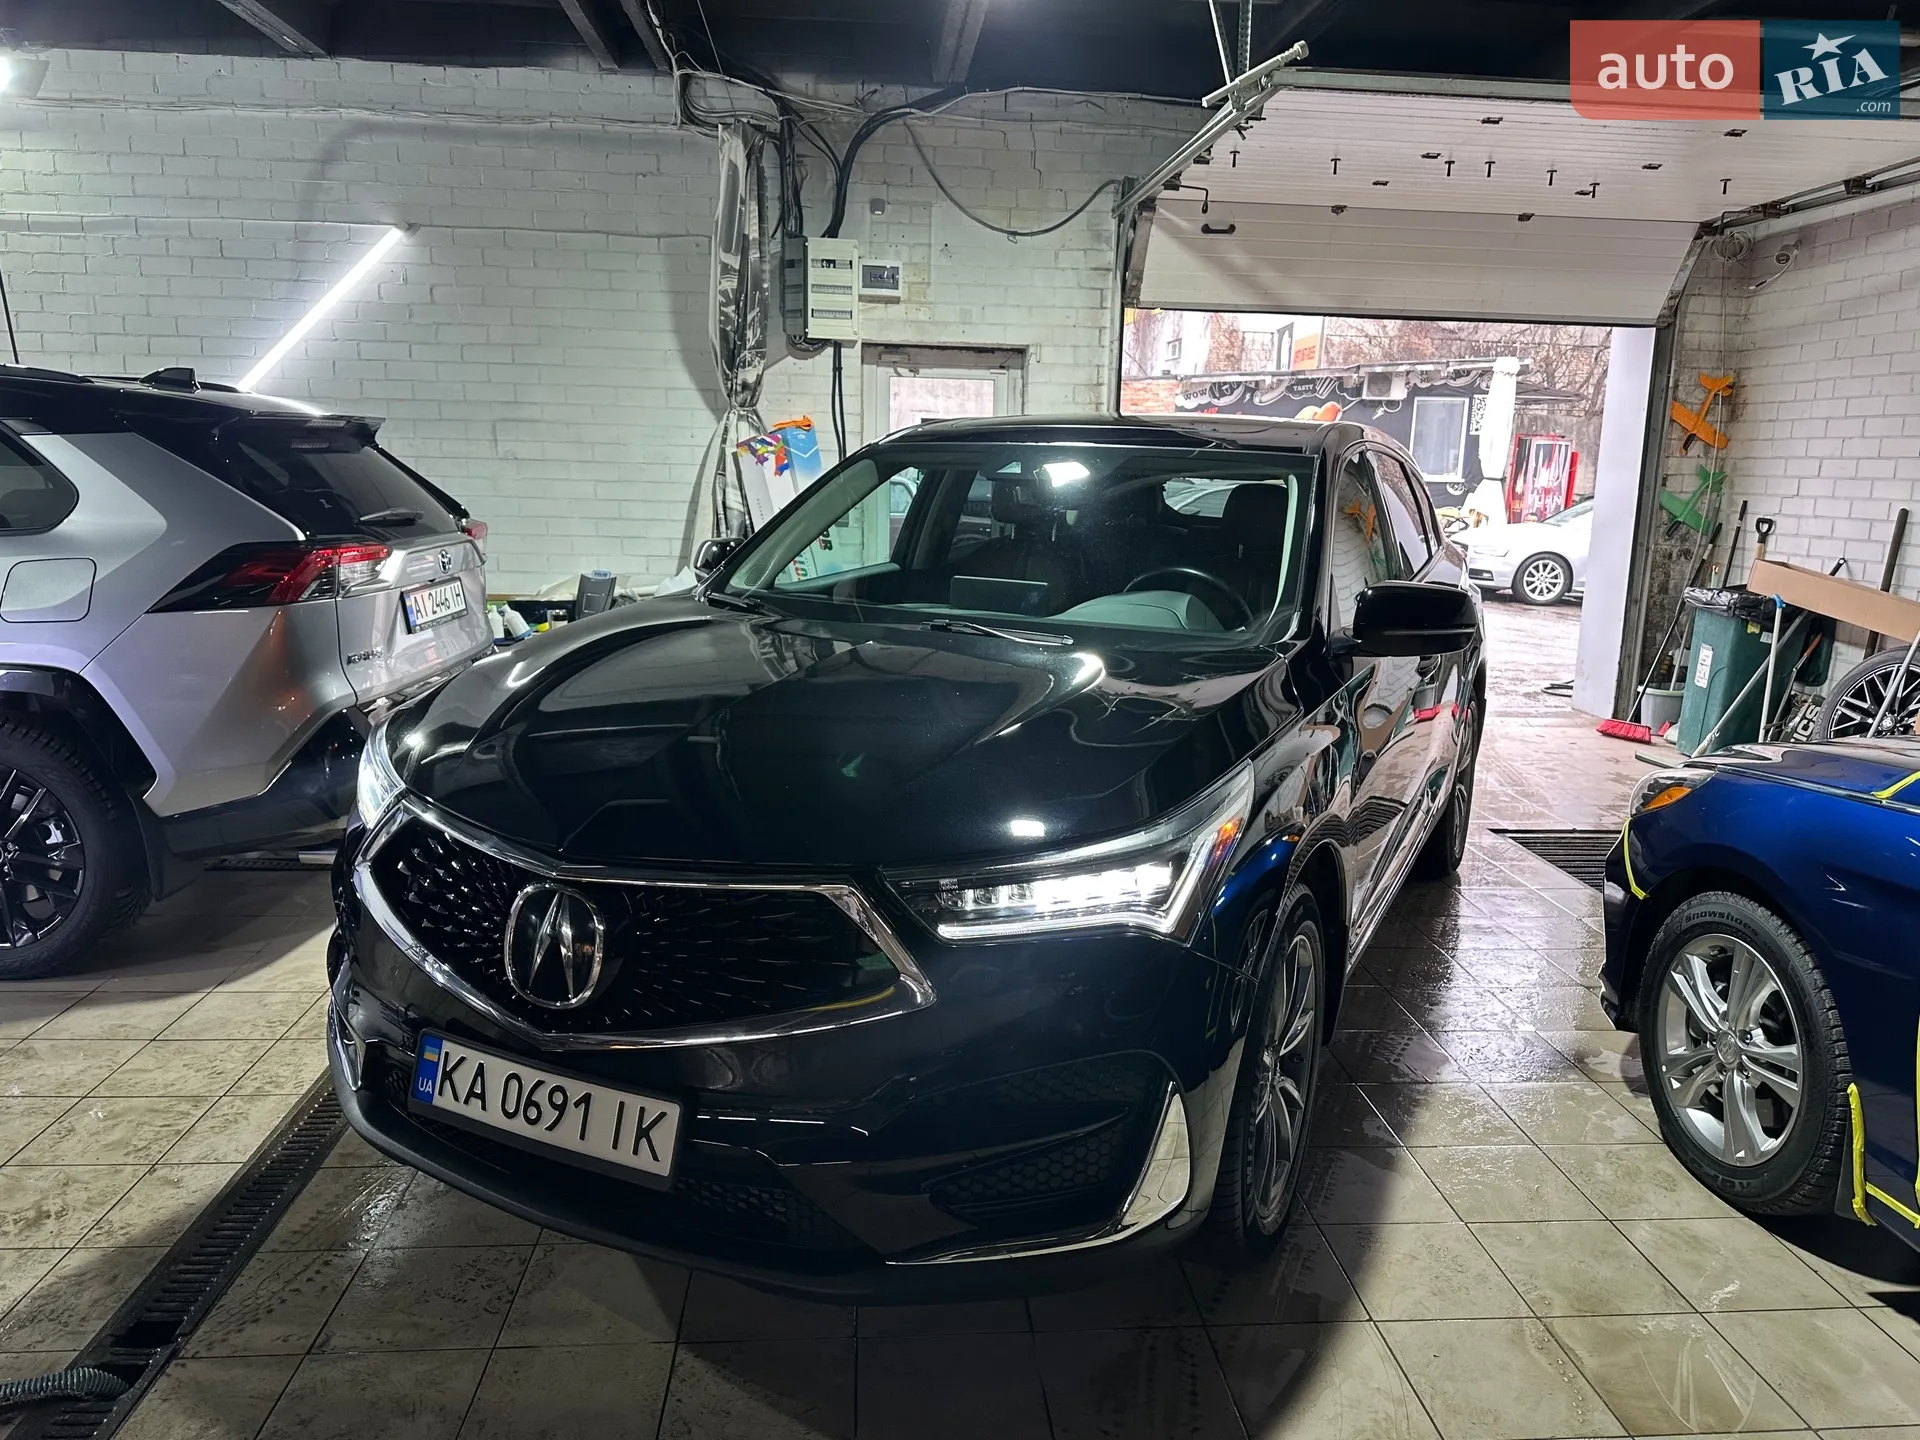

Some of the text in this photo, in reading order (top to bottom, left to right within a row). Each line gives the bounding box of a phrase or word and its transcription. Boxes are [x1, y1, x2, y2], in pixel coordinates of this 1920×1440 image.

[1183, 388, 1208, 401] WOW
[1293, 384, 1314, 392] TASTY
[413, 594, 428, 620] AI
[428, 588, 450, 615] 2446
[418, 1077, 433, 1094] UA
[438, 1051, 667, 1162] KA 0691 IK
